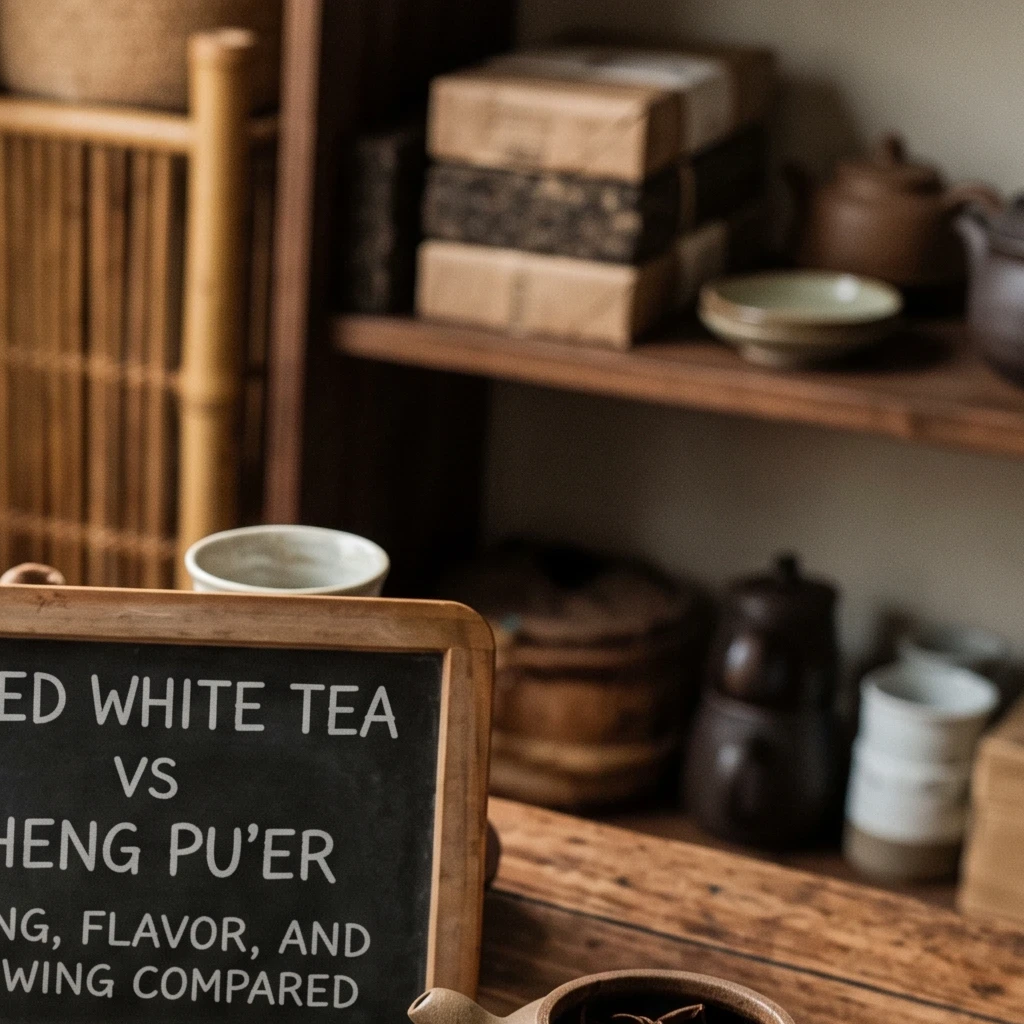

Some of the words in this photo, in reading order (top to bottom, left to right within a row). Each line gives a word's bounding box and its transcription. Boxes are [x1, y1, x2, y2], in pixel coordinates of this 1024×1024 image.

[91, 674, 265, 732] WHITE
[289, 682, 398, 739] TEA
[113, 755, 179, 799] VS
[169, 822, 337, 884] PU'ER
[81, 910, 261, 961] FLAVOR,
[278, 919, 371, 958] AND
[132, 965, 359, 1010] COMPARED
